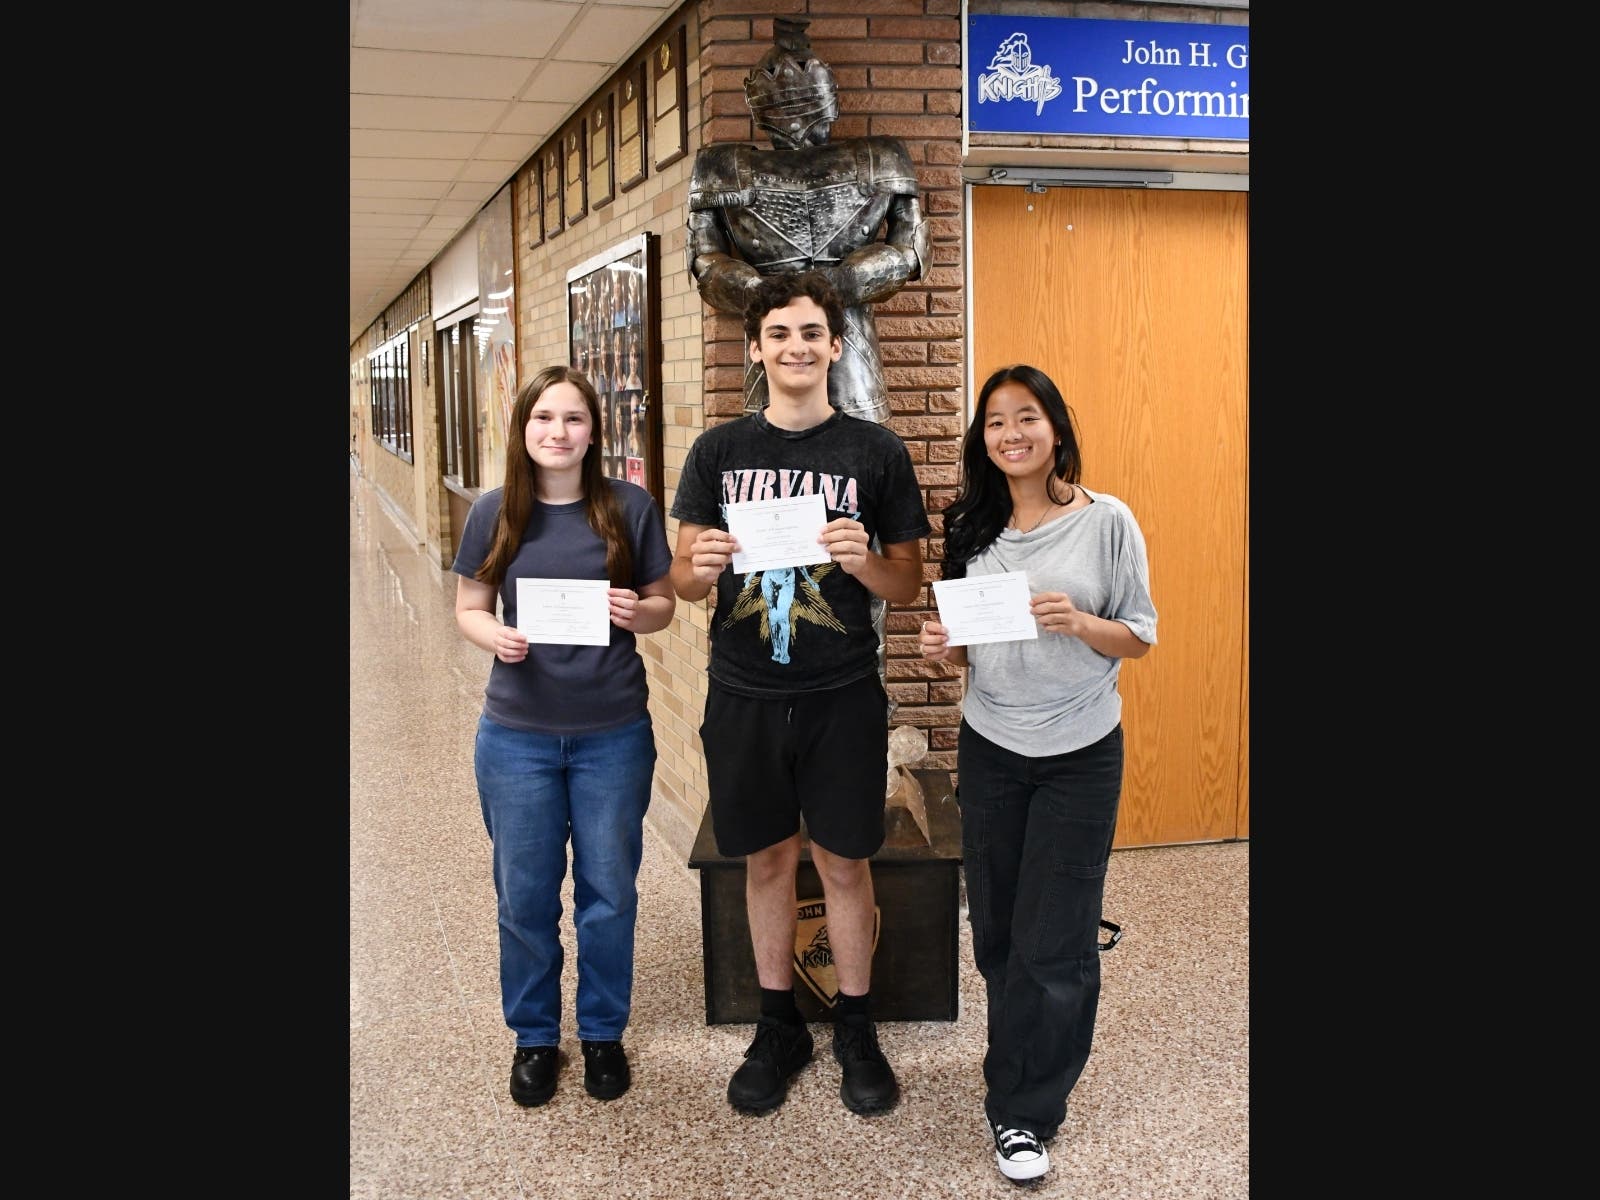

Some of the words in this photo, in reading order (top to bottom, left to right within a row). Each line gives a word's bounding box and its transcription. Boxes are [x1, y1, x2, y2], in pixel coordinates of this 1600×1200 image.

[1122, 40, 1182, 66] John
[1188, 42, 1218, 68] H.
[978, 65, 1062, 116] KNIGHTS
[721, 468, 859, 514] NIRVANA
[798, 905, 823, 919] OHN
